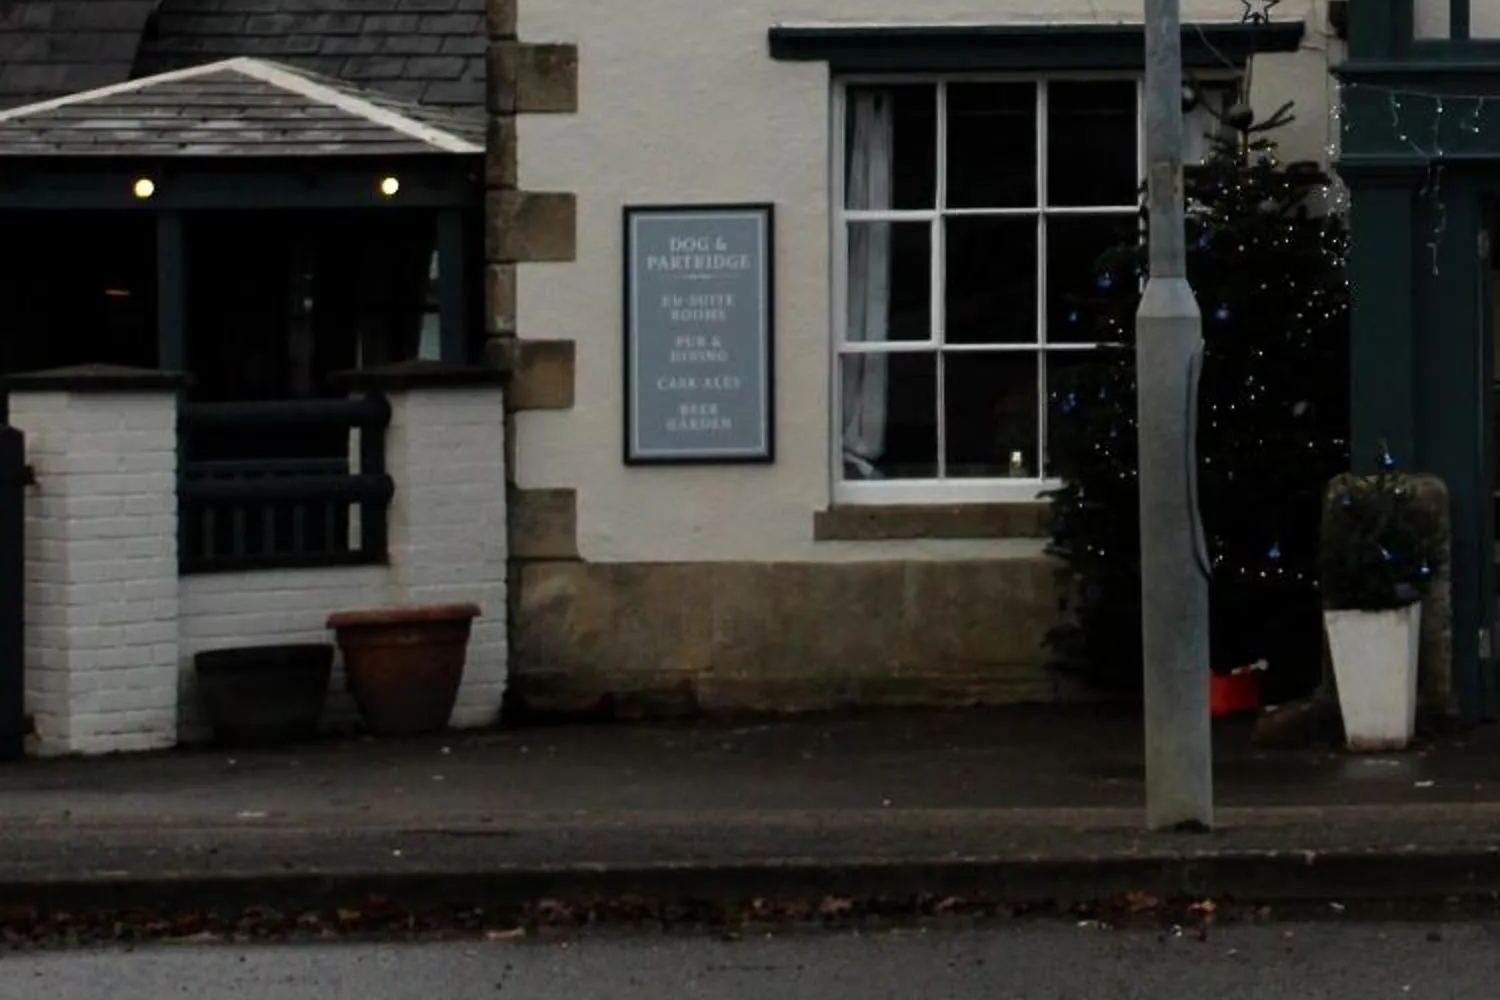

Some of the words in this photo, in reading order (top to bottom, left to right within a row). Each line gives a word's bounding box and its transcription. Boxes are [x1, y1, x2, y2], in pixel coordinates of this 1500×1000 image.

[669, 237, 709, 252] DOG
[715, 236, 728, 252] &
[646, 254, 751, 270] PARTRIDGE
